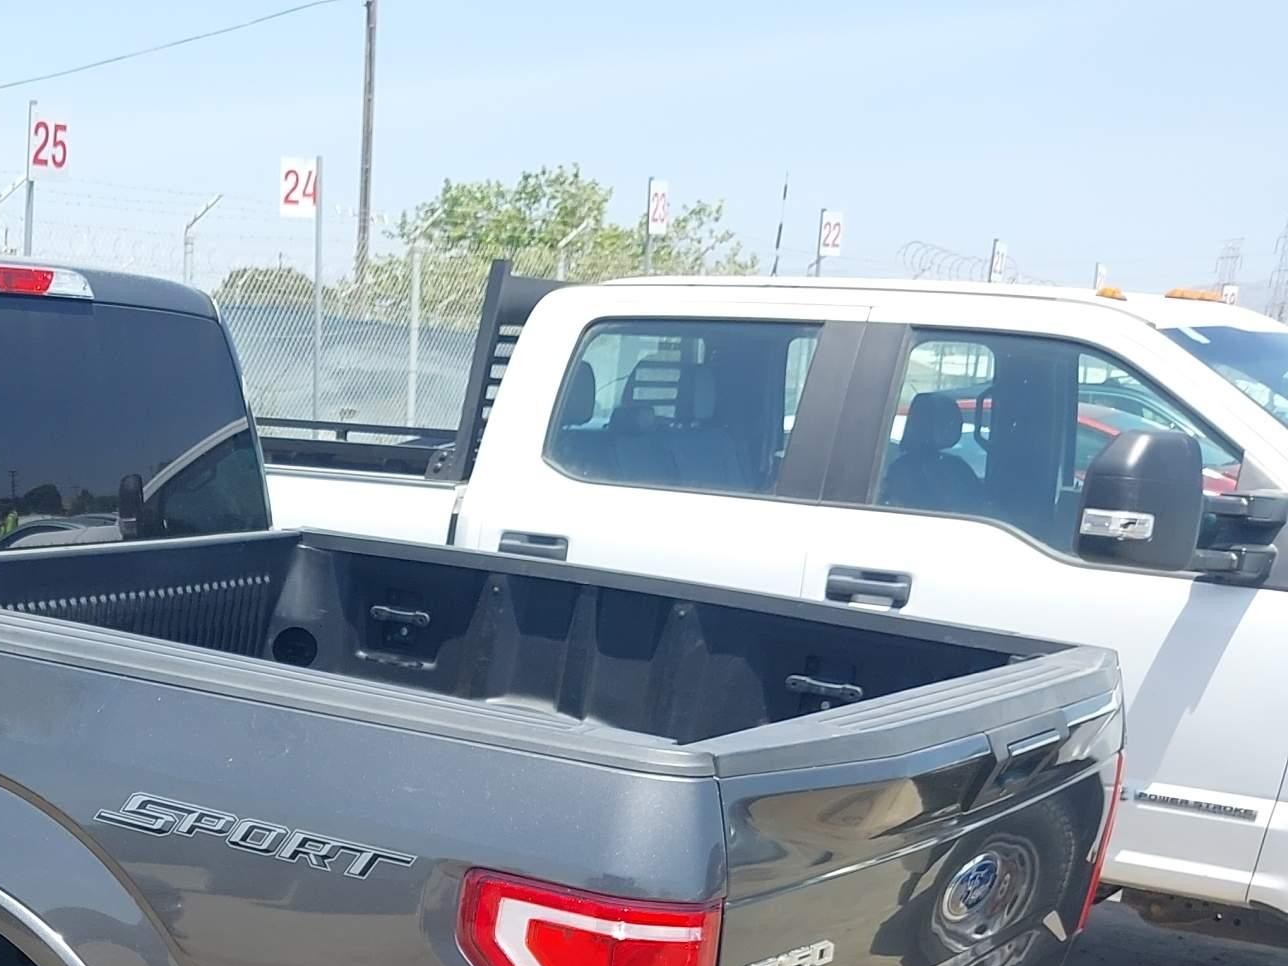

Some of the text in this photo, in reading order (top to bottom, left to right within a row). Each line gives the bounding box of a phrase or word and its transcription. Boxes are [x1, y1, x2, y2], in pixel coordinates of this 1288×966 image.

[32, 121, 67, 168] 25
[283, 169, 318, 206] 24
[822, 221, 841, 248] 22
[1137, 790, 1190, 806] POWER
[1193, 800, 1258, 817] STROKE
[93, 791, 418, 880] SPORT
